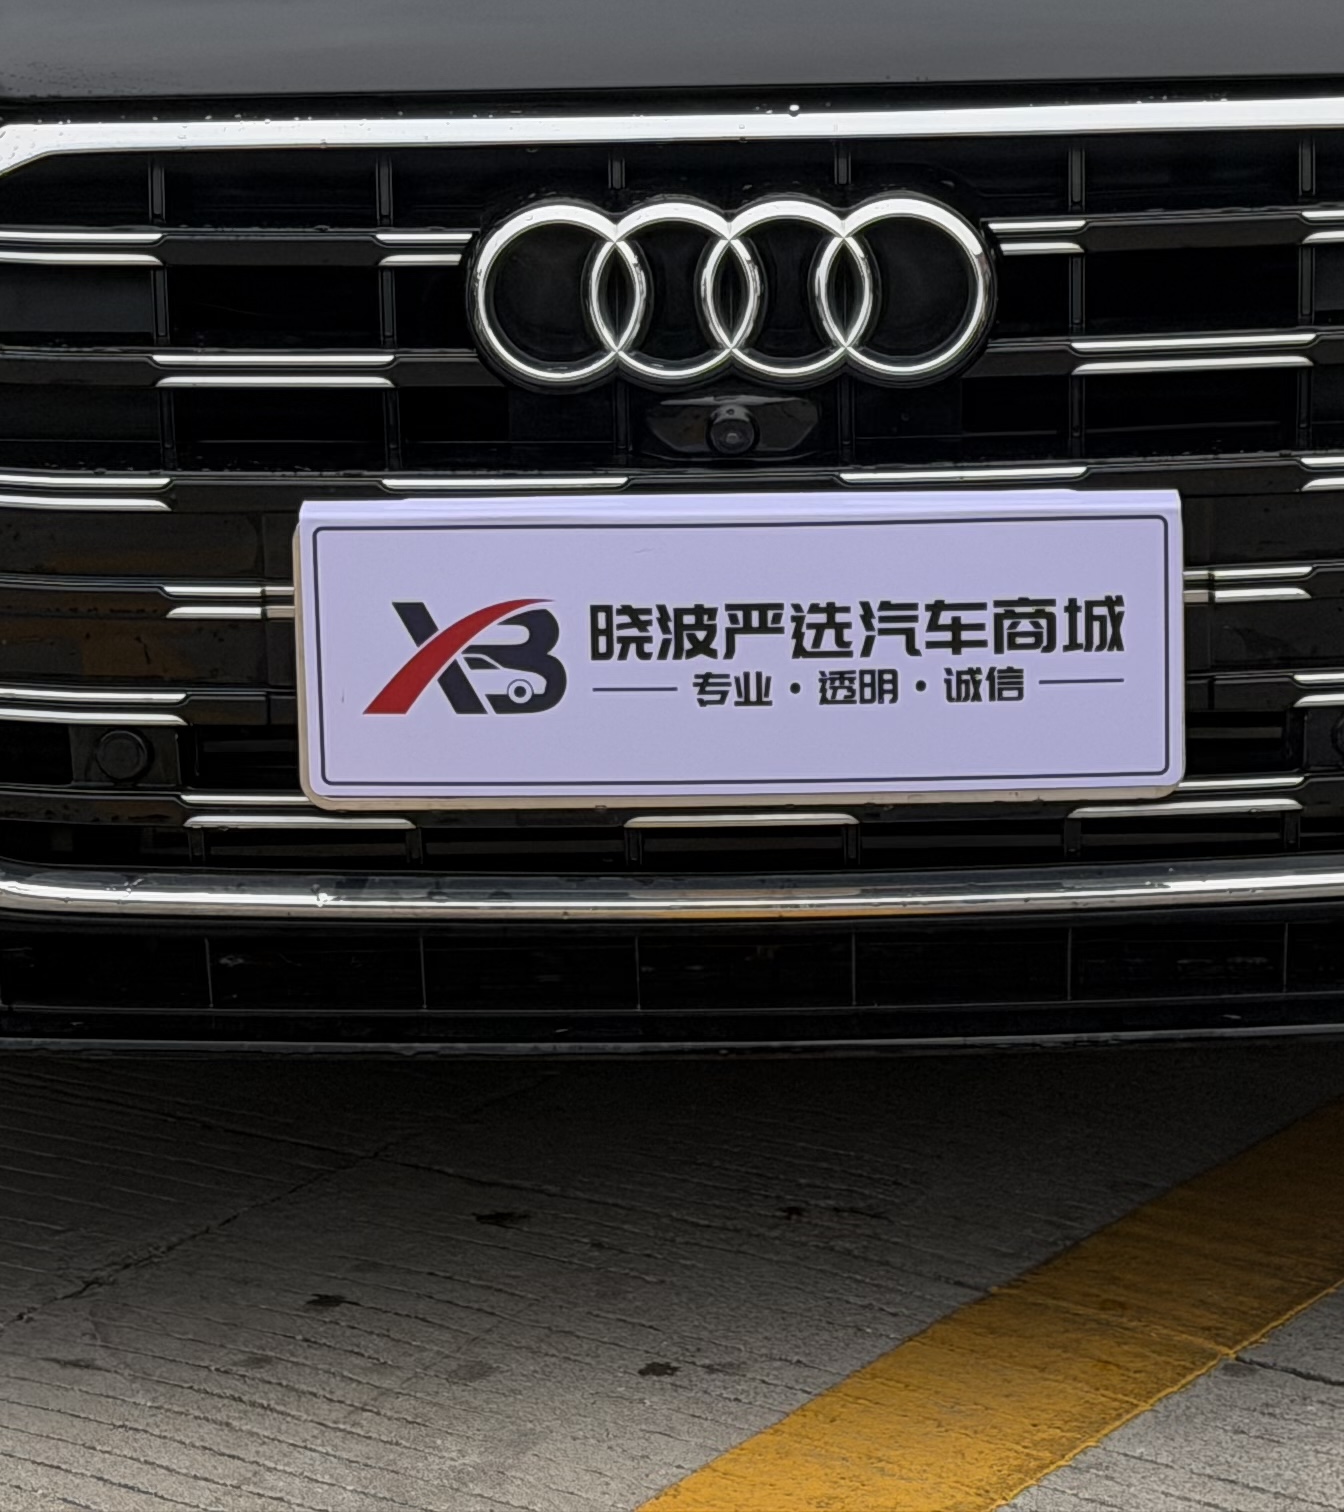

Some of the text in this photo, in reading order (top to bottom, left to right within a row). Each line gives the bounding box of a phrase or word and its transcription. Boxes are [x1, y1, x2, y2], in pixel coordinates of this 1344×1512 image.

[588, 594, 1125, 661] 晓波严选汽车商城
